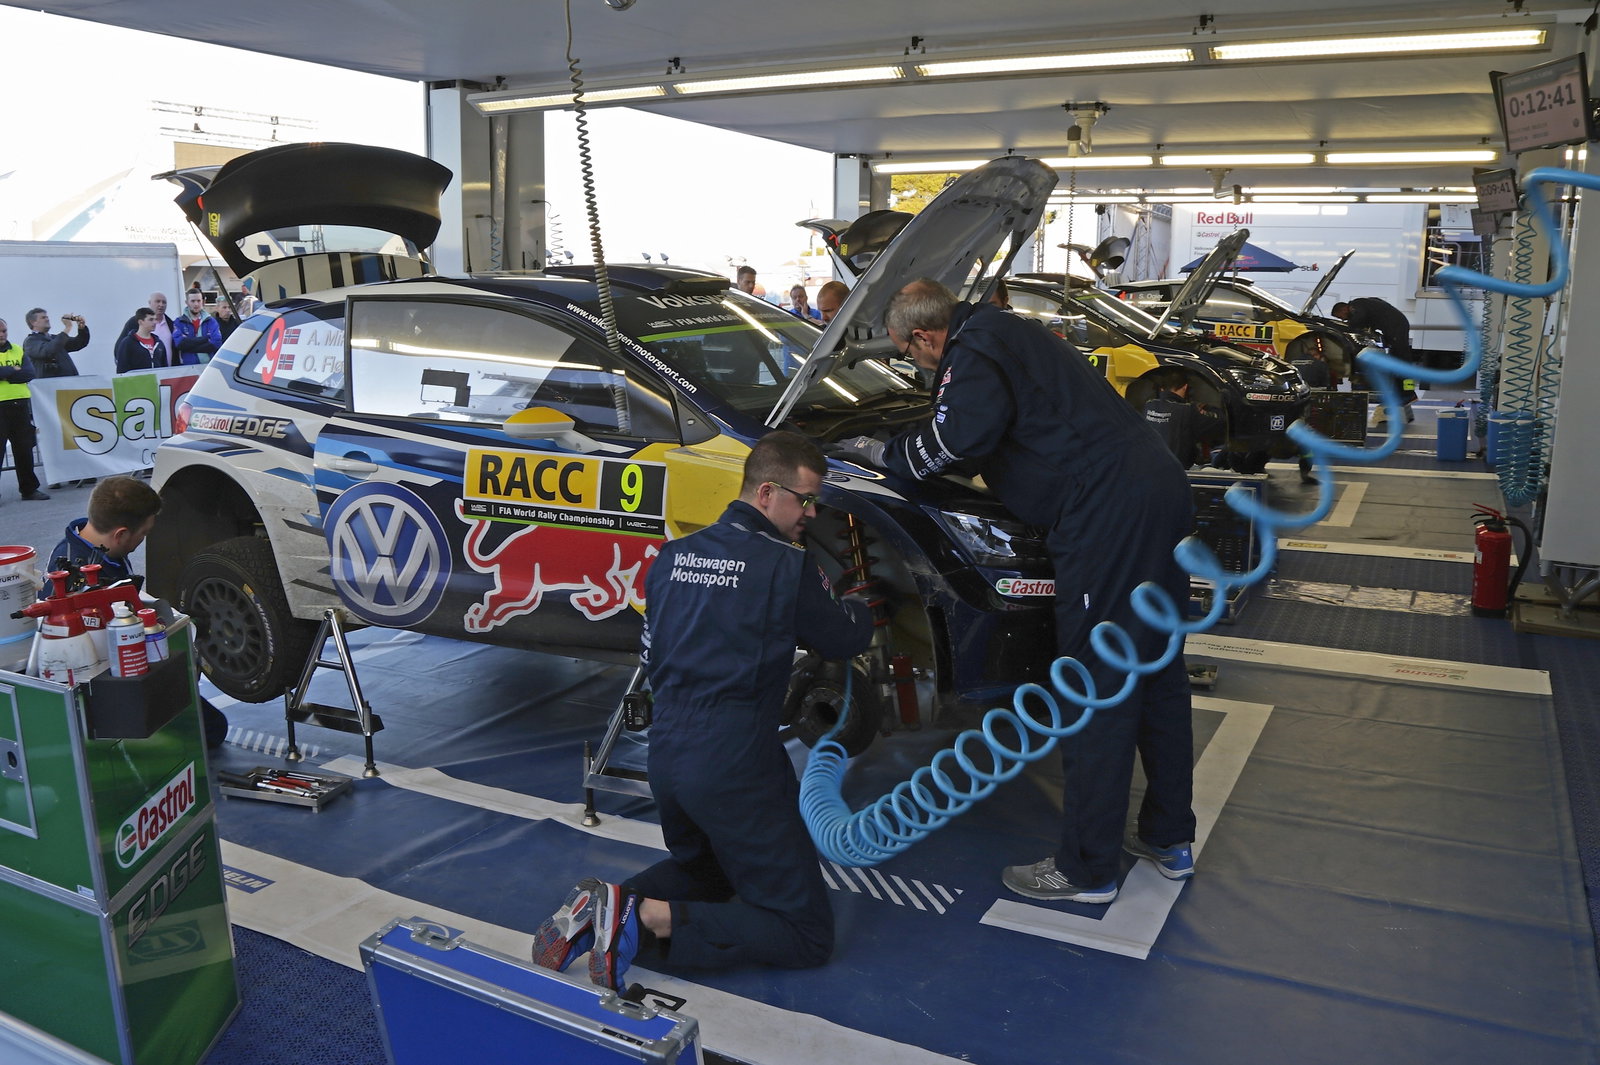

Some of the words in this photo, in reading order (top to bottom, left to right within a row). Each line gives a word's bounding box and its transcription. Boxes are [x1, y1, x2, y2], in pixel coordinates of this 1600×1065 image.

[1509, 82, 1576, 118] 0:12:41
[209, 213, 219, 237] OMP
[1197, 212, 1224, 224] Red
[1227, 212, 1253, 224] Bull
[1219, 325, 1251, 337] RACC
[1260, 326, 1267, 339] 1
[262, 317, 286, 384] 9
[69, 384, 189, 455] Sal
[200, 415, 229, 431] Castrol
[231, 417, 291, 439] EDGE
[479, 454, 584, 504] RACC
[620, 464, 643, 512] 9
[499, 506, 512, 515] FIA
[513, 508, 536, 518] World
[538, 511, 557, 521] Rally
[559, 513, 615, 527] Championship
[674, 552, 746, 573] Volkswagen
[670, 567, 739, 588] Motorsport
[138, 767, 194, 851] Castrol
[128, 833, 206, 949] EDGE
